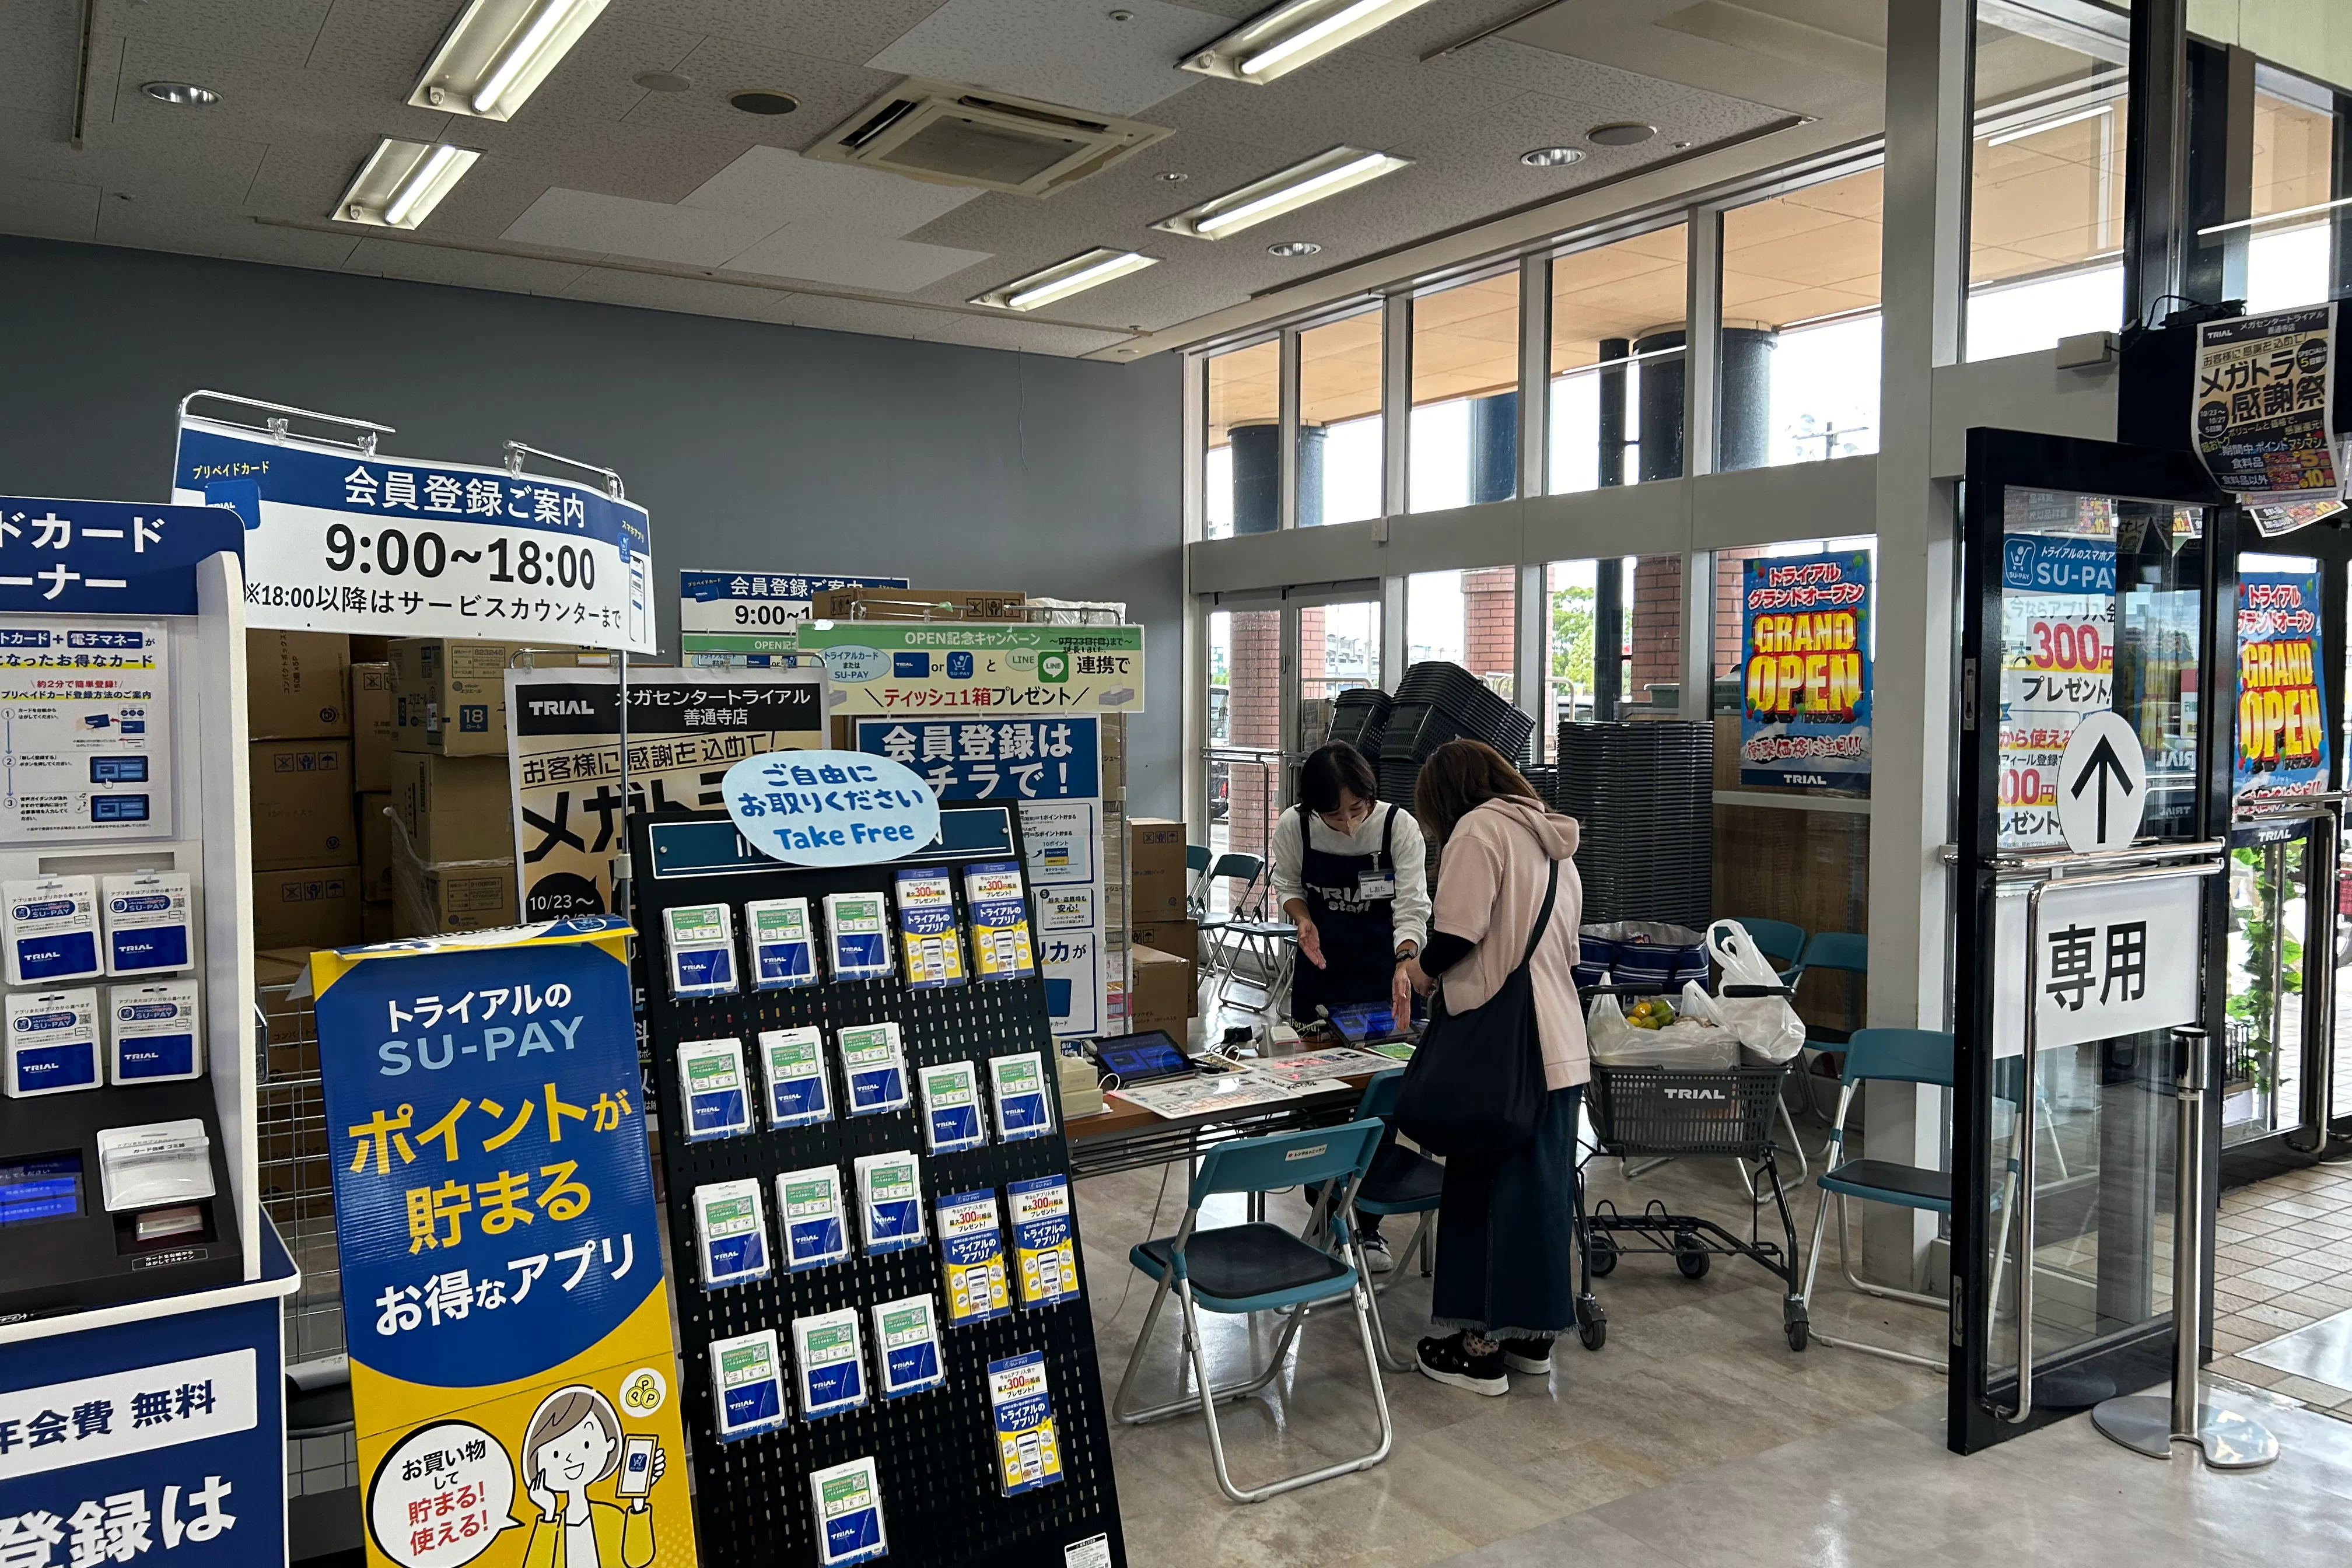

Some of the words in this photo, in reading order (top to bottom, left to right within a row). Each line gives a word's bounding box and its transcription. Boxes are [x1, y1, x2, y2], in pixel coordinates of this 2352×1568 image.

[2240, 312, 2325, 331] メガセンタートライアル
[2207, 330, 2232, 339] TRIAL
[2200, 349, 2295, 398] メガトラ
[2232, 374, 2325, 424] 感謝祭
[192, 460, 270, 480] プリペイドカード
[344, 466, 585, 528] 会員登録ご案内
[0, 511, 165, 553] ドカード
[2042, 545, 2116, 562] トライアルのスマホア
[1769, 562, 1842, 587] トライアル
[2009, 572, 2029, 580] SU-PAY
[1748, 583, 1866, 610] グランドオープン
[2248, 584, 2301, 609] トライアル
[245, 582, 622, 631] ※18:00以降はサービスカウンターまで
[2237, 610, 2315, 636] グランドオープン
[71, 633, 140, 646] 電子マネー
[905, 631, 1041, 646] OPEN記念キャンペーン
[1753, 611, 1856, 653] GRAND
[823, 650, 879, 660] トライアルカード
[1012, 656, 1035, 664] LINE
[931, 662, 945, 673] or
[986, 660, 996, 672] と
[1076, 655, 1130, 674] 連携で
[2242, 641, 2314, 688] GRAND
[834, 670, 869, 679] SU-PAY
[1748, 653, 1862, 713] OPEN
[2022, 676, 2113, 705] プレゼント!
[1, 690, 152, 699] プリペイドカード登録方法のご案内
[614, 689, 811, 708] メガセンタートライアル
[884, 687, 1072, 707] ティッシュ1箱プレゼント
[528, 700, 594, 716] TRIAL
[463, 709, 484, 723] 18
[683, 708, 748, 727] 善通寺店
[2239, 688, 2322, 761] OPEN
[881, 723, 1073, 762] 会員登録は
[522, 730, 776, 785] お客様に感謝を込めて!
[762, 763, 878, 787] ご自由に
[1783, 774, 1827, 785] TRIAL
[1999, 768, 2056, 805] 00円
[737, 789, 924, 818] お取りください
[773, 825, 845, 850] Take
[850, 822, 915, 845] Free
[2258, 828, 2292, 842] TRIAL
[32, 908, 70, 918] SU-PAY
[129, 903, 166, 911] SU-PAY
[979, 906, 1021, 918] トライアルの
[1056, 903, 1079, 913] 安心!
[908, 913, 950, 925] トライアルの
[989, 916, 1015, 926] アプリ!
[917, 923, 944, 933] アプリ!
[118, 944, 154, 952] TRIAL
[24, 951, 61, 961] TRIAL
[763, 956, 787, 964] TRIAL
[682, 963, 706, 972] TRIAL
[2045, 920, 2147, 1012] 専用
[136, 1011, 173, 1019] SU-PAY
[388, 982, 572, 1033] トライアルの
[33, 1020, 71, 1030] SU-PAY
[379, 1015, 584, 1077] SU-PAY
[22, 1062, 60, 1072] TRIAL
[856, 1083, 880, 1092] TRIAL
[1664, 1088, 1726, 1100] TRIAL
[778, 1093, 802, 1102] TRIAL
[695, 1105, 720, 1115] TRIAL
[1005, 1108, 1026, 1116] TRIAL
[349, 1082, 633, 1175] ポイントが
[936, 1120, 957, 1129] TRIAL
[405, 1159, 592, 1255] 貯まる
[874, 1215, 897, 1224] TRIAL
[795, 1234, 819, 1244] TRIAL
[1024, 1224, 1066, 1240] トライアルの
[951, 1238, 996, 1255] トライアルの
[1034, 1233, 1060, 1248] アプリ!
[714, 1250, 739, 1260] TRIAL
[962, 1249, 990, 1264] アプリ!
[374, 1233, 634, 1336] お得なアプリ
[892, 1360, 915, 1370] TRIAL
[812, 1379, 836, 1389] TRIAL
[729, 1399, 755, 1409] TRIAL
[0, 1401, 114, 1454] 年会費
[131, 1379, 216, 1429] 無料
[1000, 1402, 1045, 1423] トライアルの
[1012, 1415, 1039, 1430] アプリ!
[402, 1438, 487, 1482] お買い物
[434, 1471, 459, 1490] して
[408, 1481, 485, 1527] 貯まる!
[410, 1510, 489, 1556] 使える!
[831, 1528, 856, 1540] TRIAL
